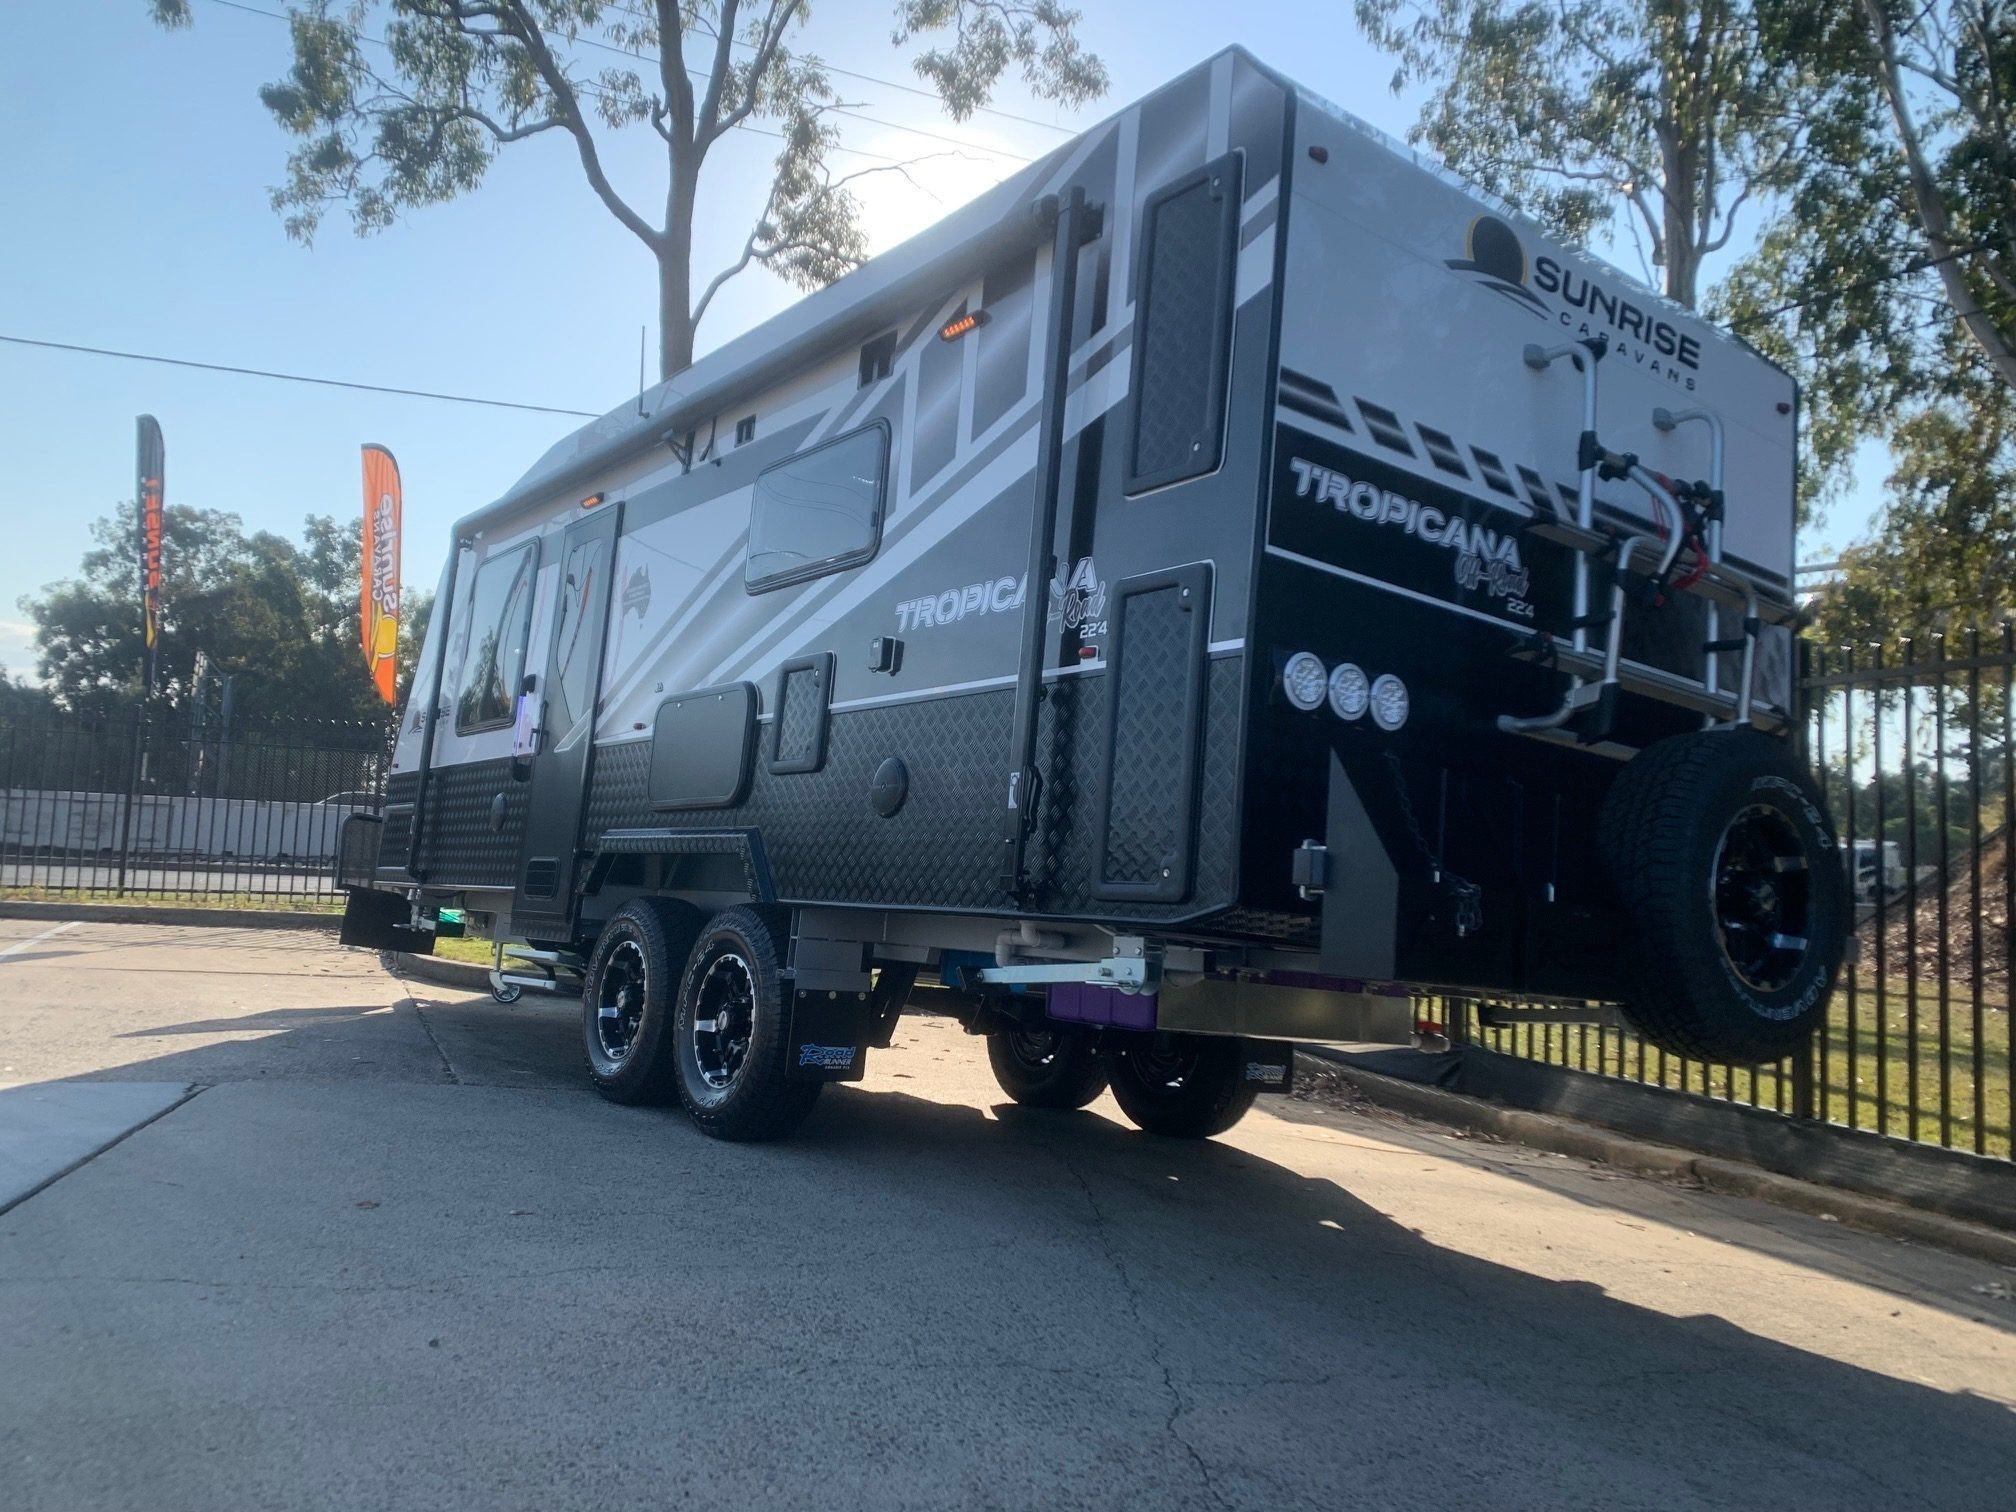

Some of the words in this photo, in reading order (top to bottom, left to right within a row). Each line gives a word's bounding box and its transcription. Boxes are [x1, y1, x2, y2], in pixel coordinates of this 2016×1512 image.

[1534, 256, 1701, 370] SUNRISE
[1290, 456, 1522, 573] TROPICANA
[1079, 620, 1108, 639] 22'4
